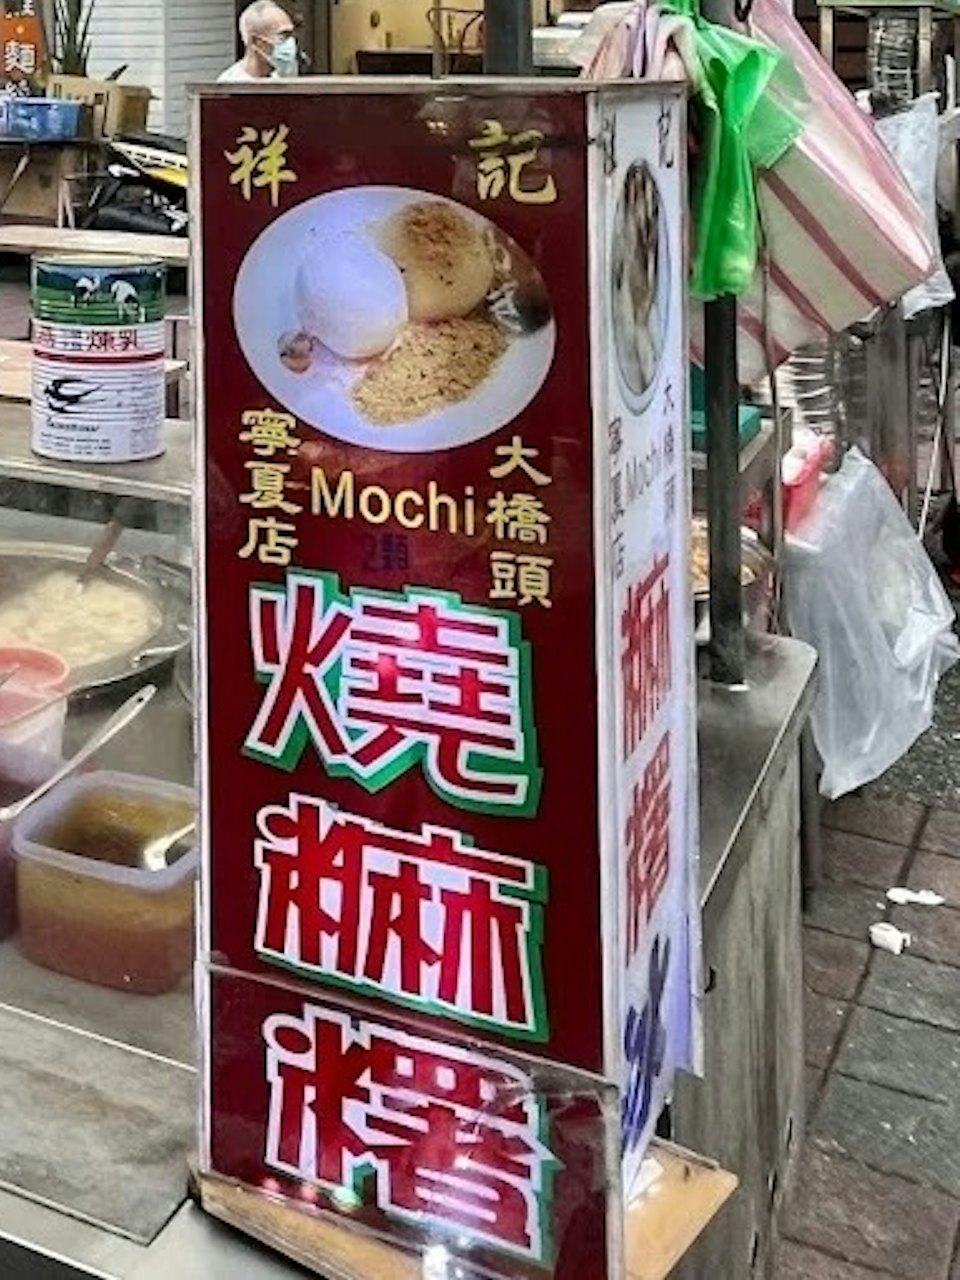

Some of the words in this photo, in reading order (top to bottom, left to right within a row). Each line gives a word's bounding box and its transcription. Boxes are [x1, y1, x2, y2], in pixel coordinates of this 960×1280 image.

[237, 408, 304, 568] 寧夏店
[311, 466, 476, 536] Mochi
[486, 436, 554, 609] 大橋頭
